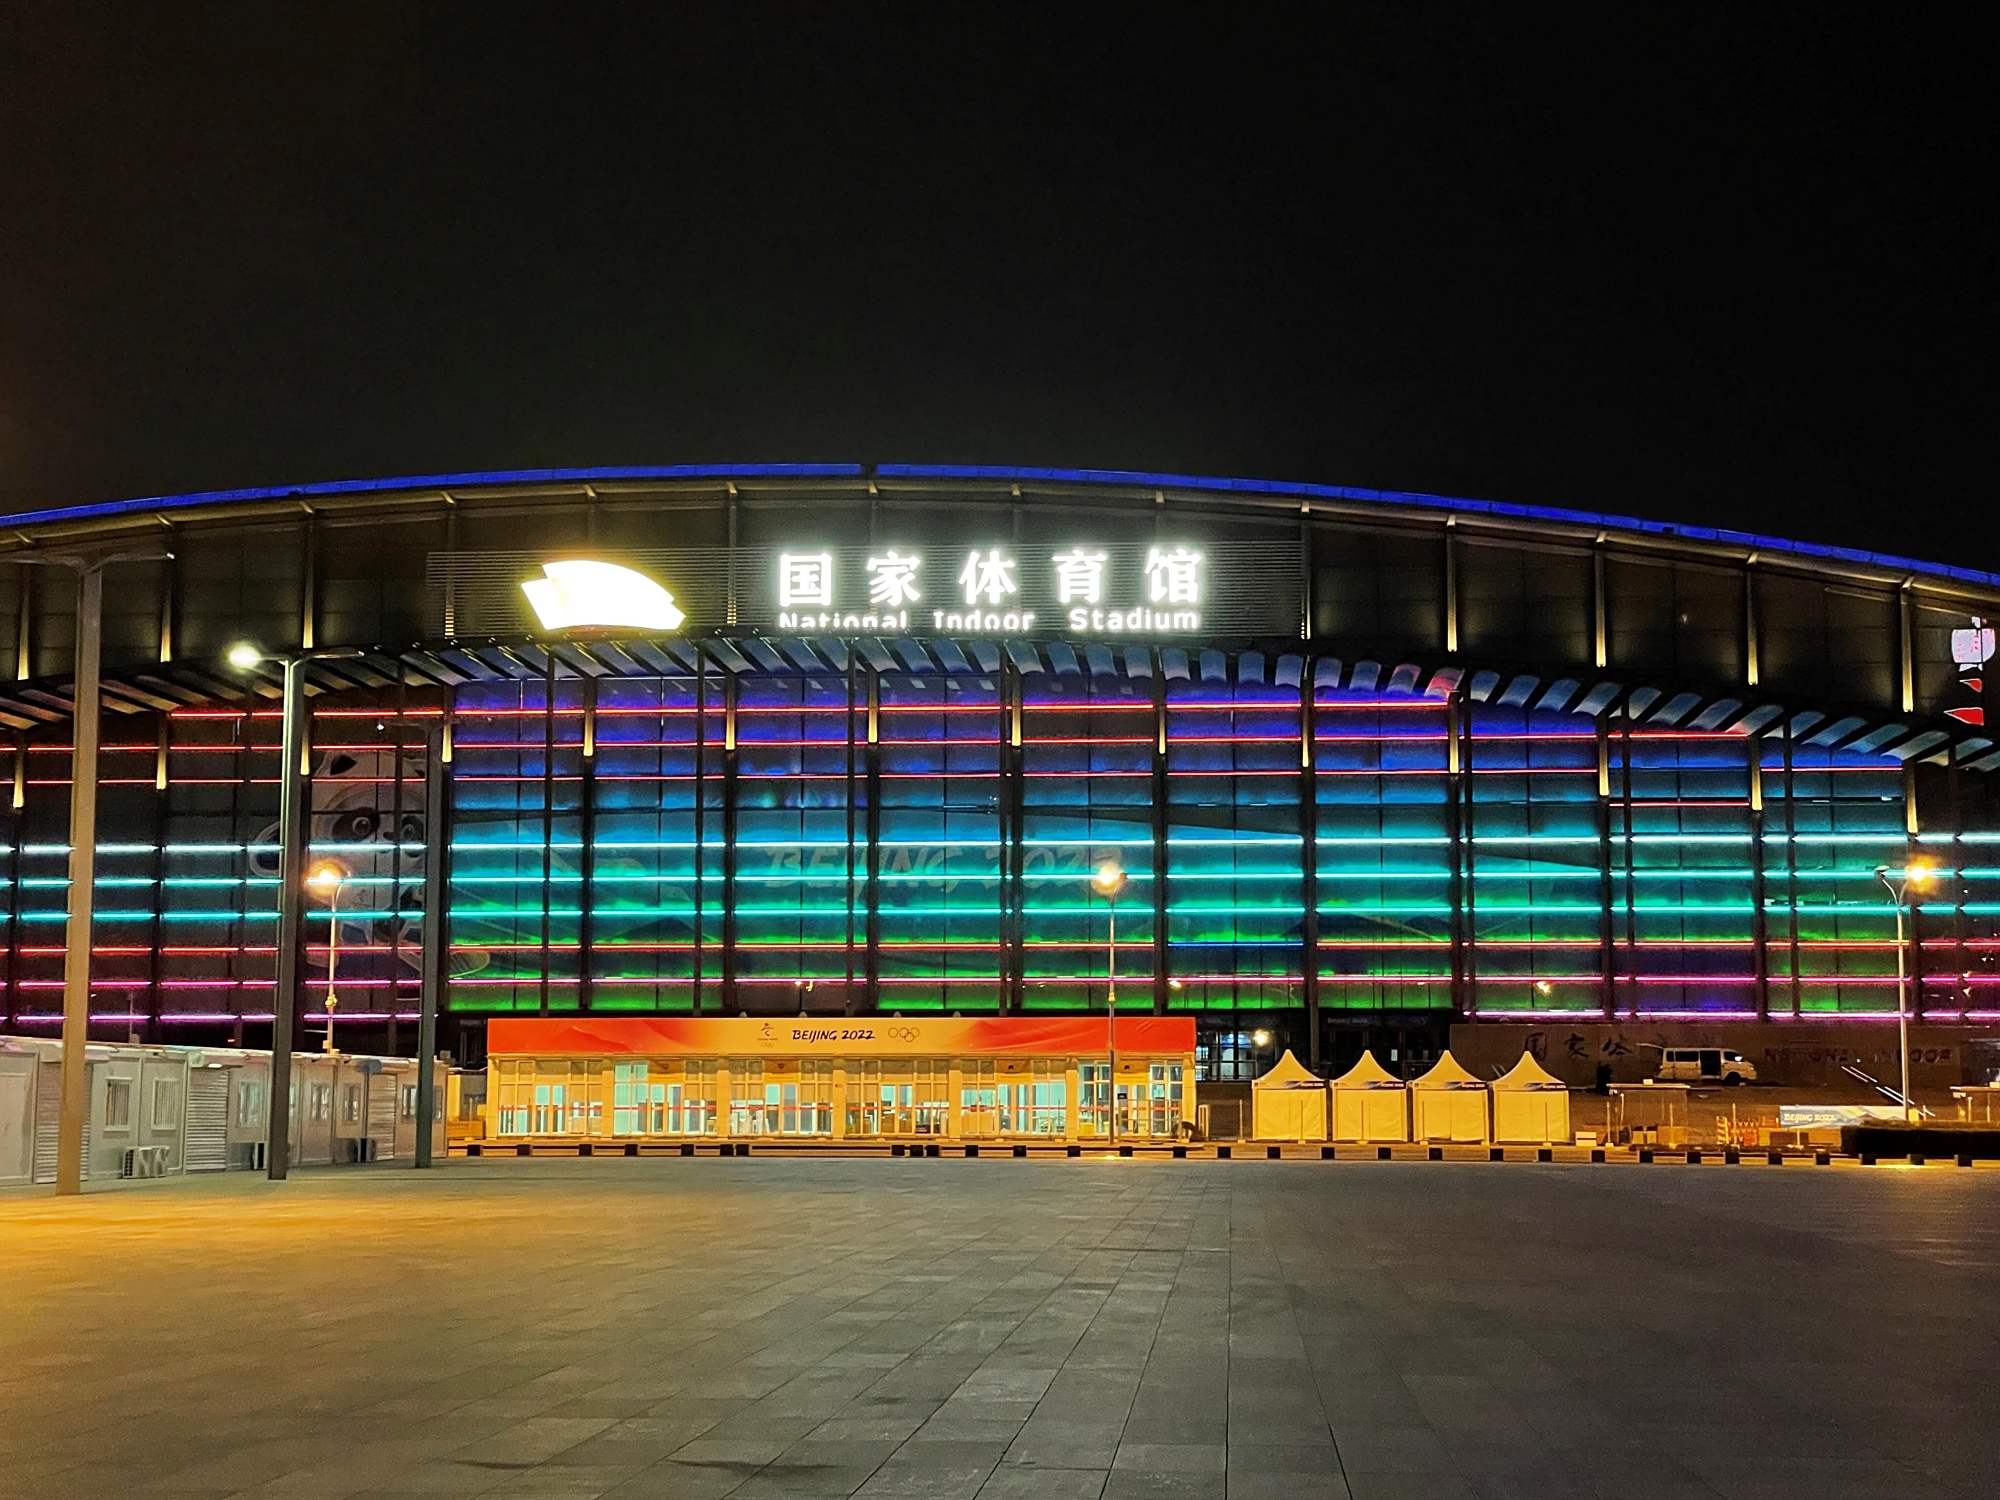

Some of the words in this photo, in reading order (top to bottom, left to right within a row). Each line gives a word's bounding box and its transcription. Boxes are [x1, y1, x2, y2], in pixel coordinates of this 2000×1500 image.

[780, 548, 1202, 607] 国家体育馆
[779, 610, 907, 628] National
[933, 609, 1035, 630] Indoor
[1069, 607, 1199, 630] Stadium
[791, 1029, 838, 1043] BEIJING
[841, 1029, 876, 1040] 2022
